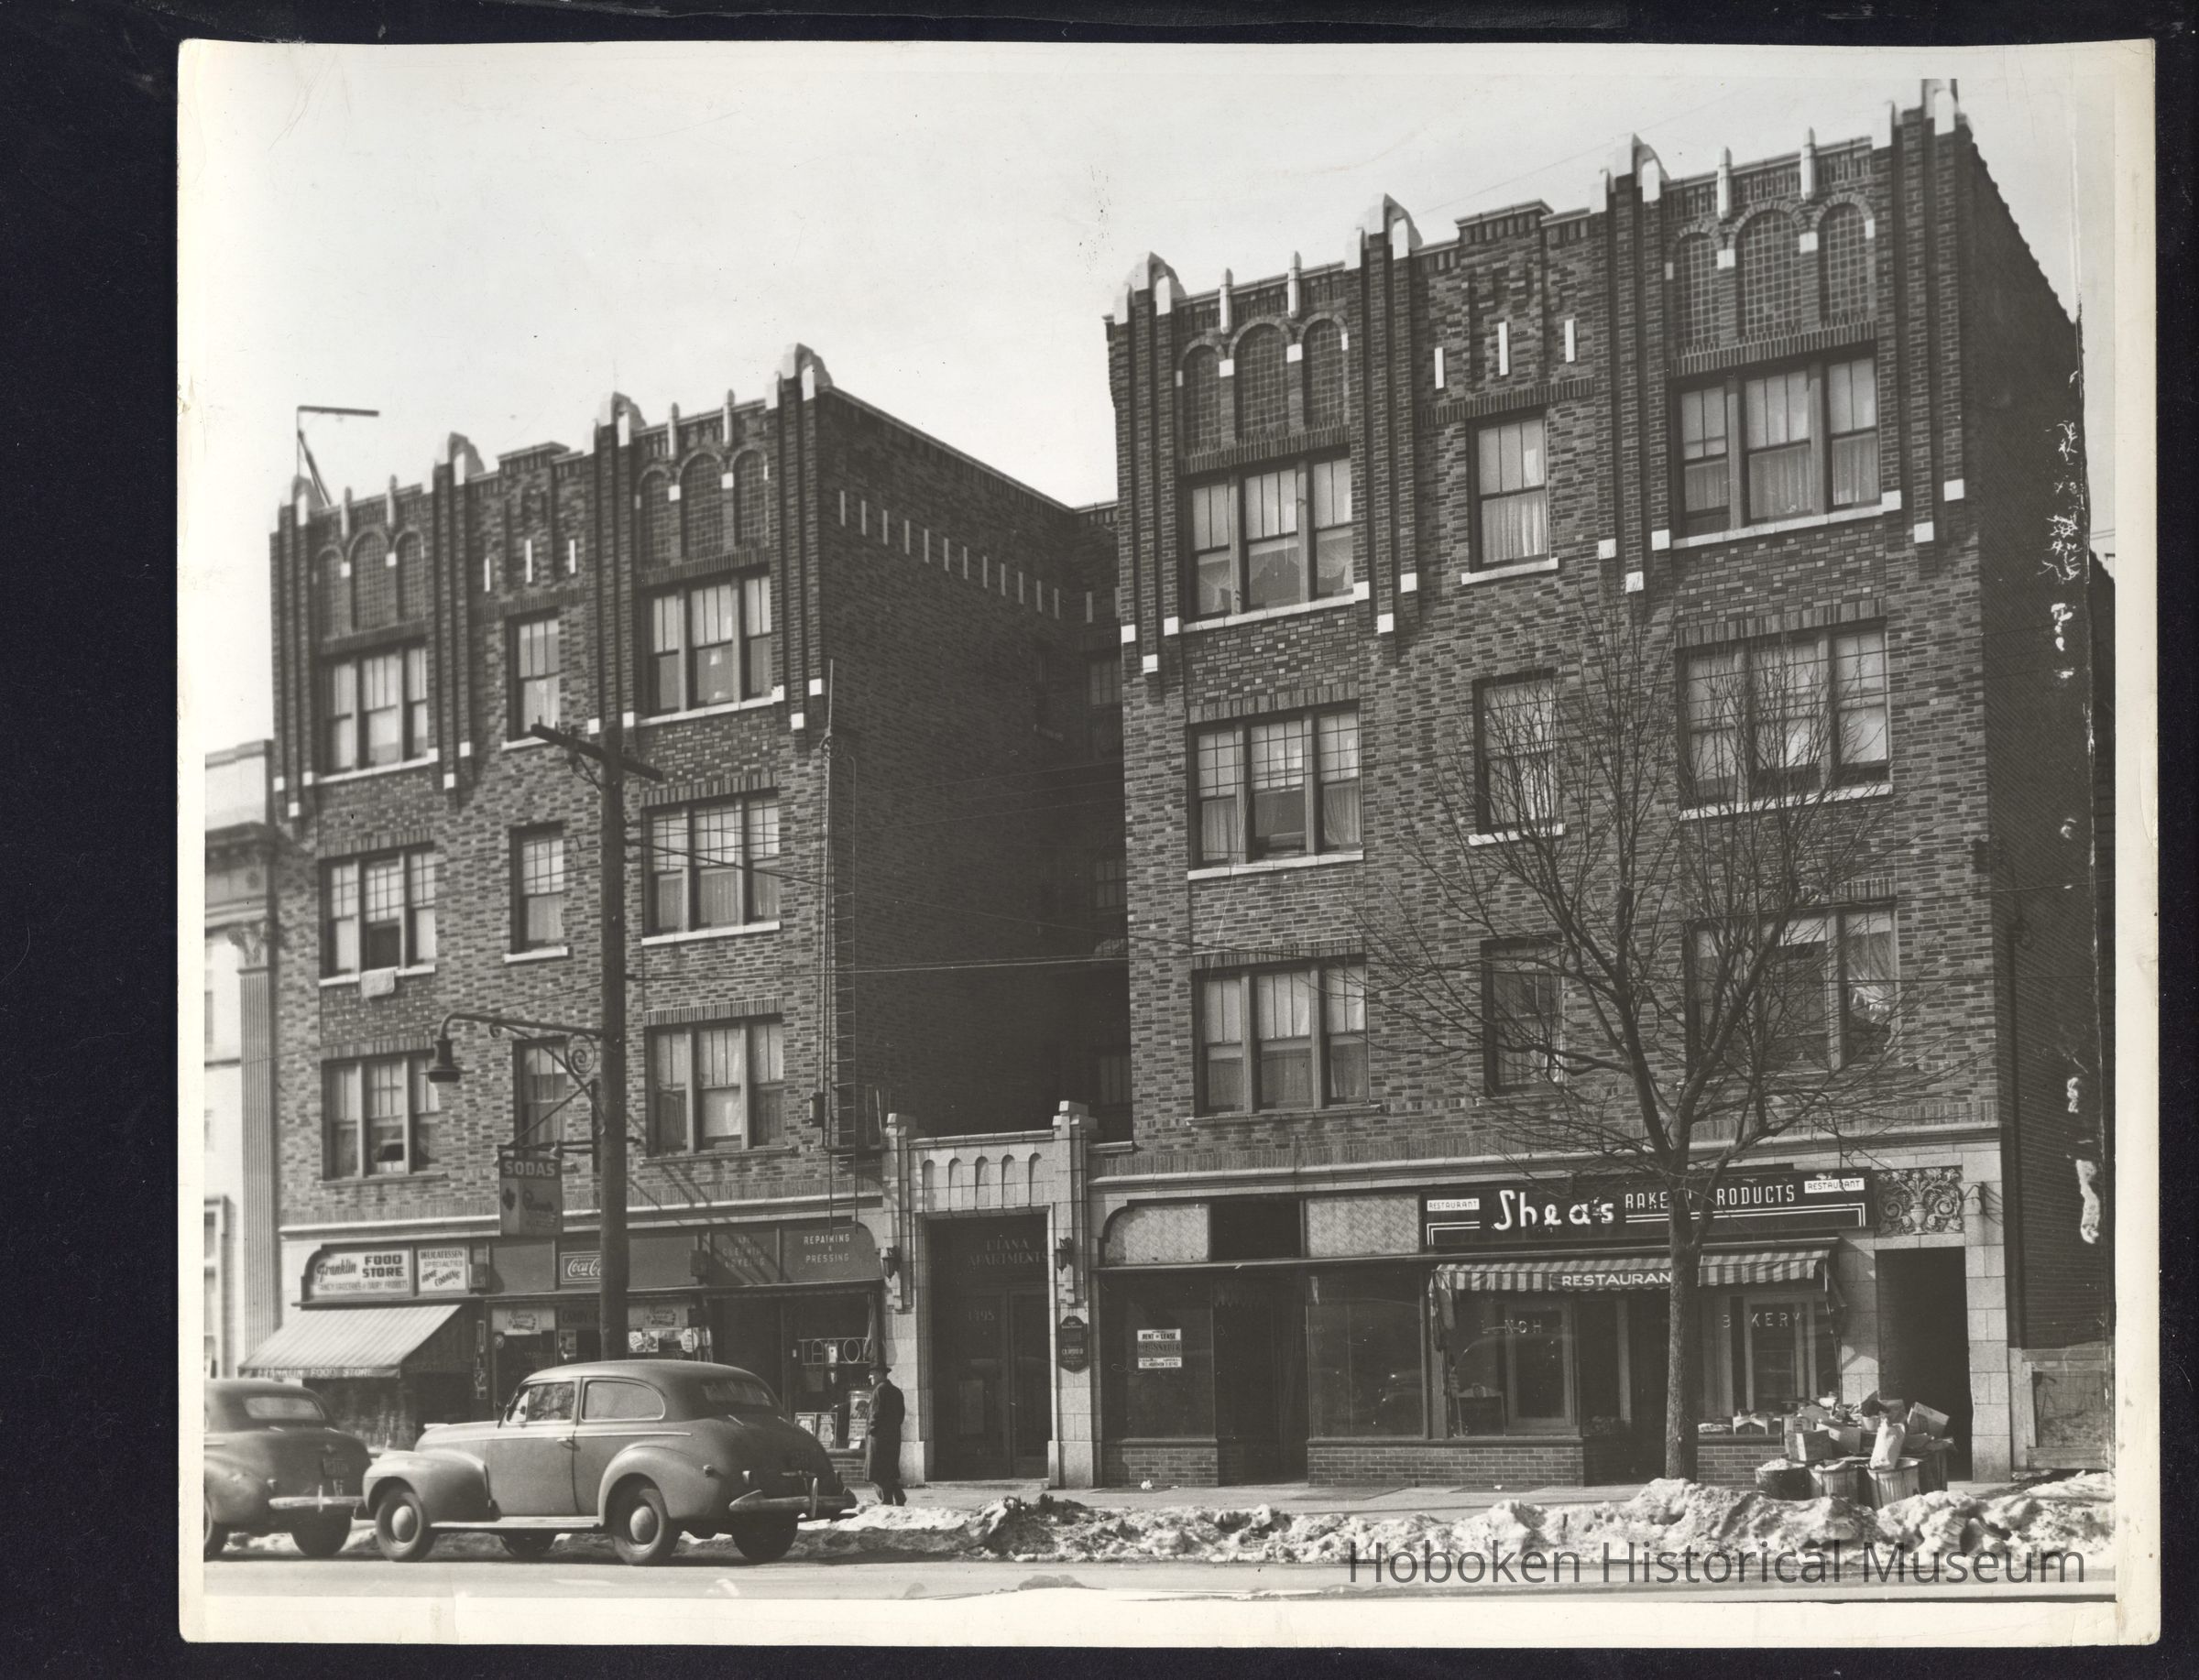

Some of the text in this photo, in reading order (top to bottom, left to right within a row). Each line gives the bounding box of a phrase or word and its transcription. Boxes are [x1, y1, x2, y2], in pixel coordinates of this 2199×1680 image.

[504, 1161, 555, 1176] SODAS
[1428, 1199, 1479, 1210] RESTAURANT
[1493, 1184, 1795, 1230] Shea's BAKE RODUCTS
[804, 1234, 850, 1245] REPAIRING
[986, 1238, 1030, 1251] DIANA
[420, 1249, 463, 1260] DELICATESSEN
[722, 1246, 768, 1256] CLENIN
[805, 1253, 849, 1263] PRESSING
[365, 1254, 403, 1265] FOOD
[316, 1259, 357, 1282] Franklin
[362, 1266, 404, 1278] STORE
[567, 1258, 601, 1277] Coca-Co
[1561, 1271, 1671, 1287] RESTAURAN
[1481, 1319, 1541, 1334] LNCH
[1722, 1312, 1800, 1328] BKERY
[796, 1336, 874, 1366] TAOR
